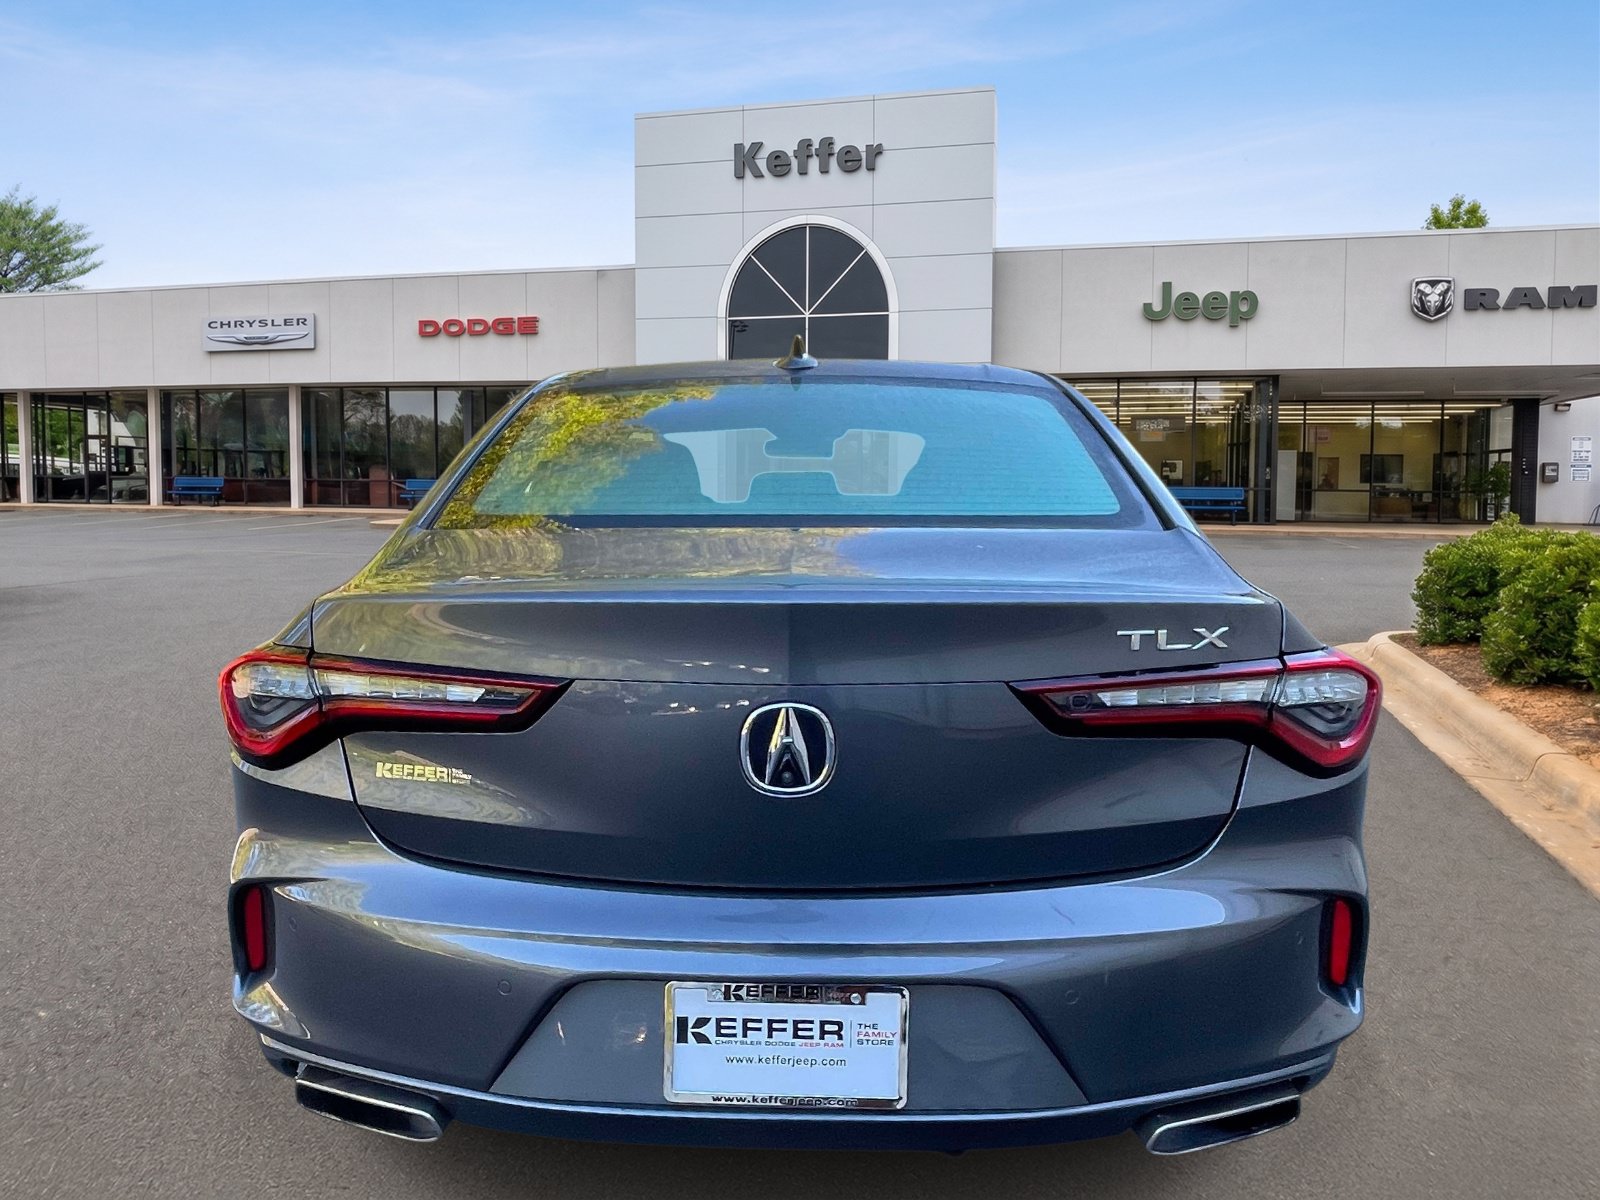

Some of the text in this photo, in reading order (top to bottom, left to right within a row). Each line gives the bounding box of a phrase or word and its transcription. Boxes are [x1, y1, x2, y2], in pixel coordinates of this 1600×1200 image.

[733, 136, 883, 178] Keffer
[1143, 281, 1258, 327] Jeep
[1464, 285, 1598, 311] RAM
[207, 317, 308, 329] CHRYSLER
[418, 316, 539, 337] DODGE
[1116, 626, 1230, 651] TLX
[375, 761, 448, 779] KEFFER
[723, 984, 820, 1000] KEFFER
[676, 1016, 844, 1044] KEFFER
[725, 1054, 847, 1068] www.kefferjeep.com
[711, 1094, 859, 1107] www.kefferjeep.com
